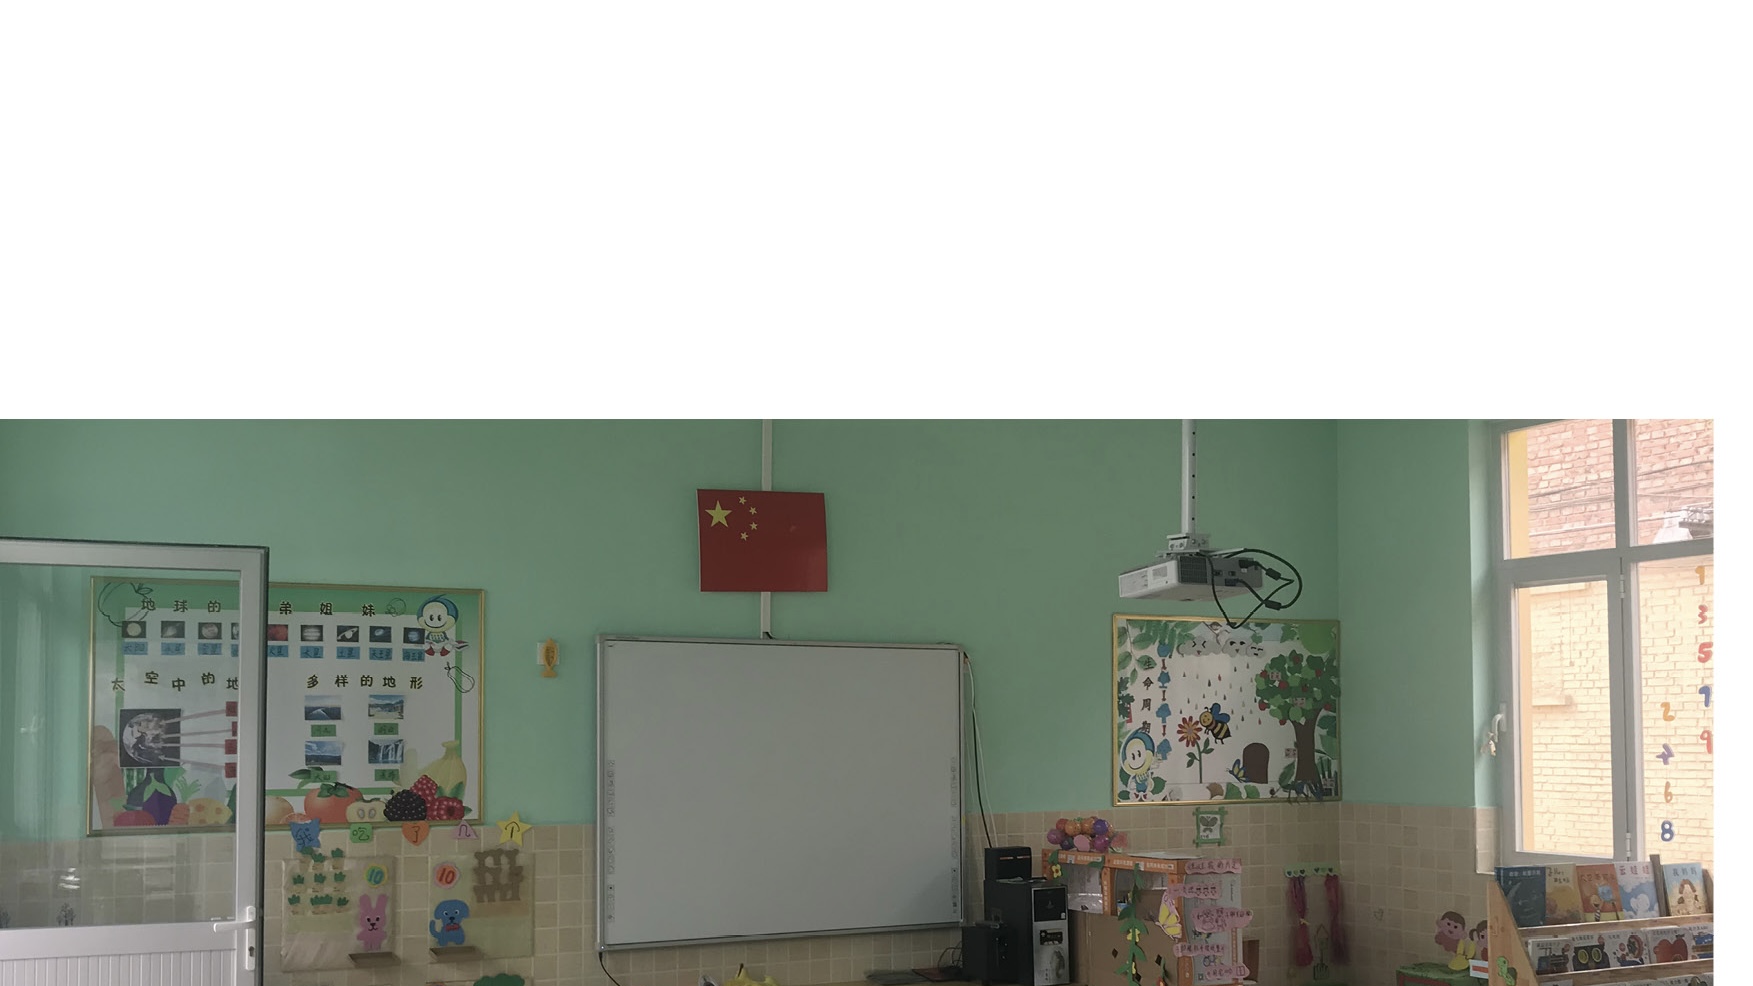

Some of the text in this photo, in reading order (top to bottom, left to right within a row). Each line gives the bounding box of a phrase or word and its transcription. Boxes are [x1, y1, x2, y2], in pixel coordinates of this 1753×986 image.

[1695, 565, 1706, 586] 1
[1697, 604, 1708, 624] 3
[1698, 641, 1713, 663] 5
[306, 673, 424, 690] 多样的地形
[1142, 658, 1154, 734] 生命周期
[1660, 702, 1676, 722] 2
[1700, 730, 1713, 754] 9
[1663, 781, 1673, 803] 6
[1660, 819, 1675, 843] 8
[367, 868, 385, 885] 10
[438, 870, 457, 886] 10
